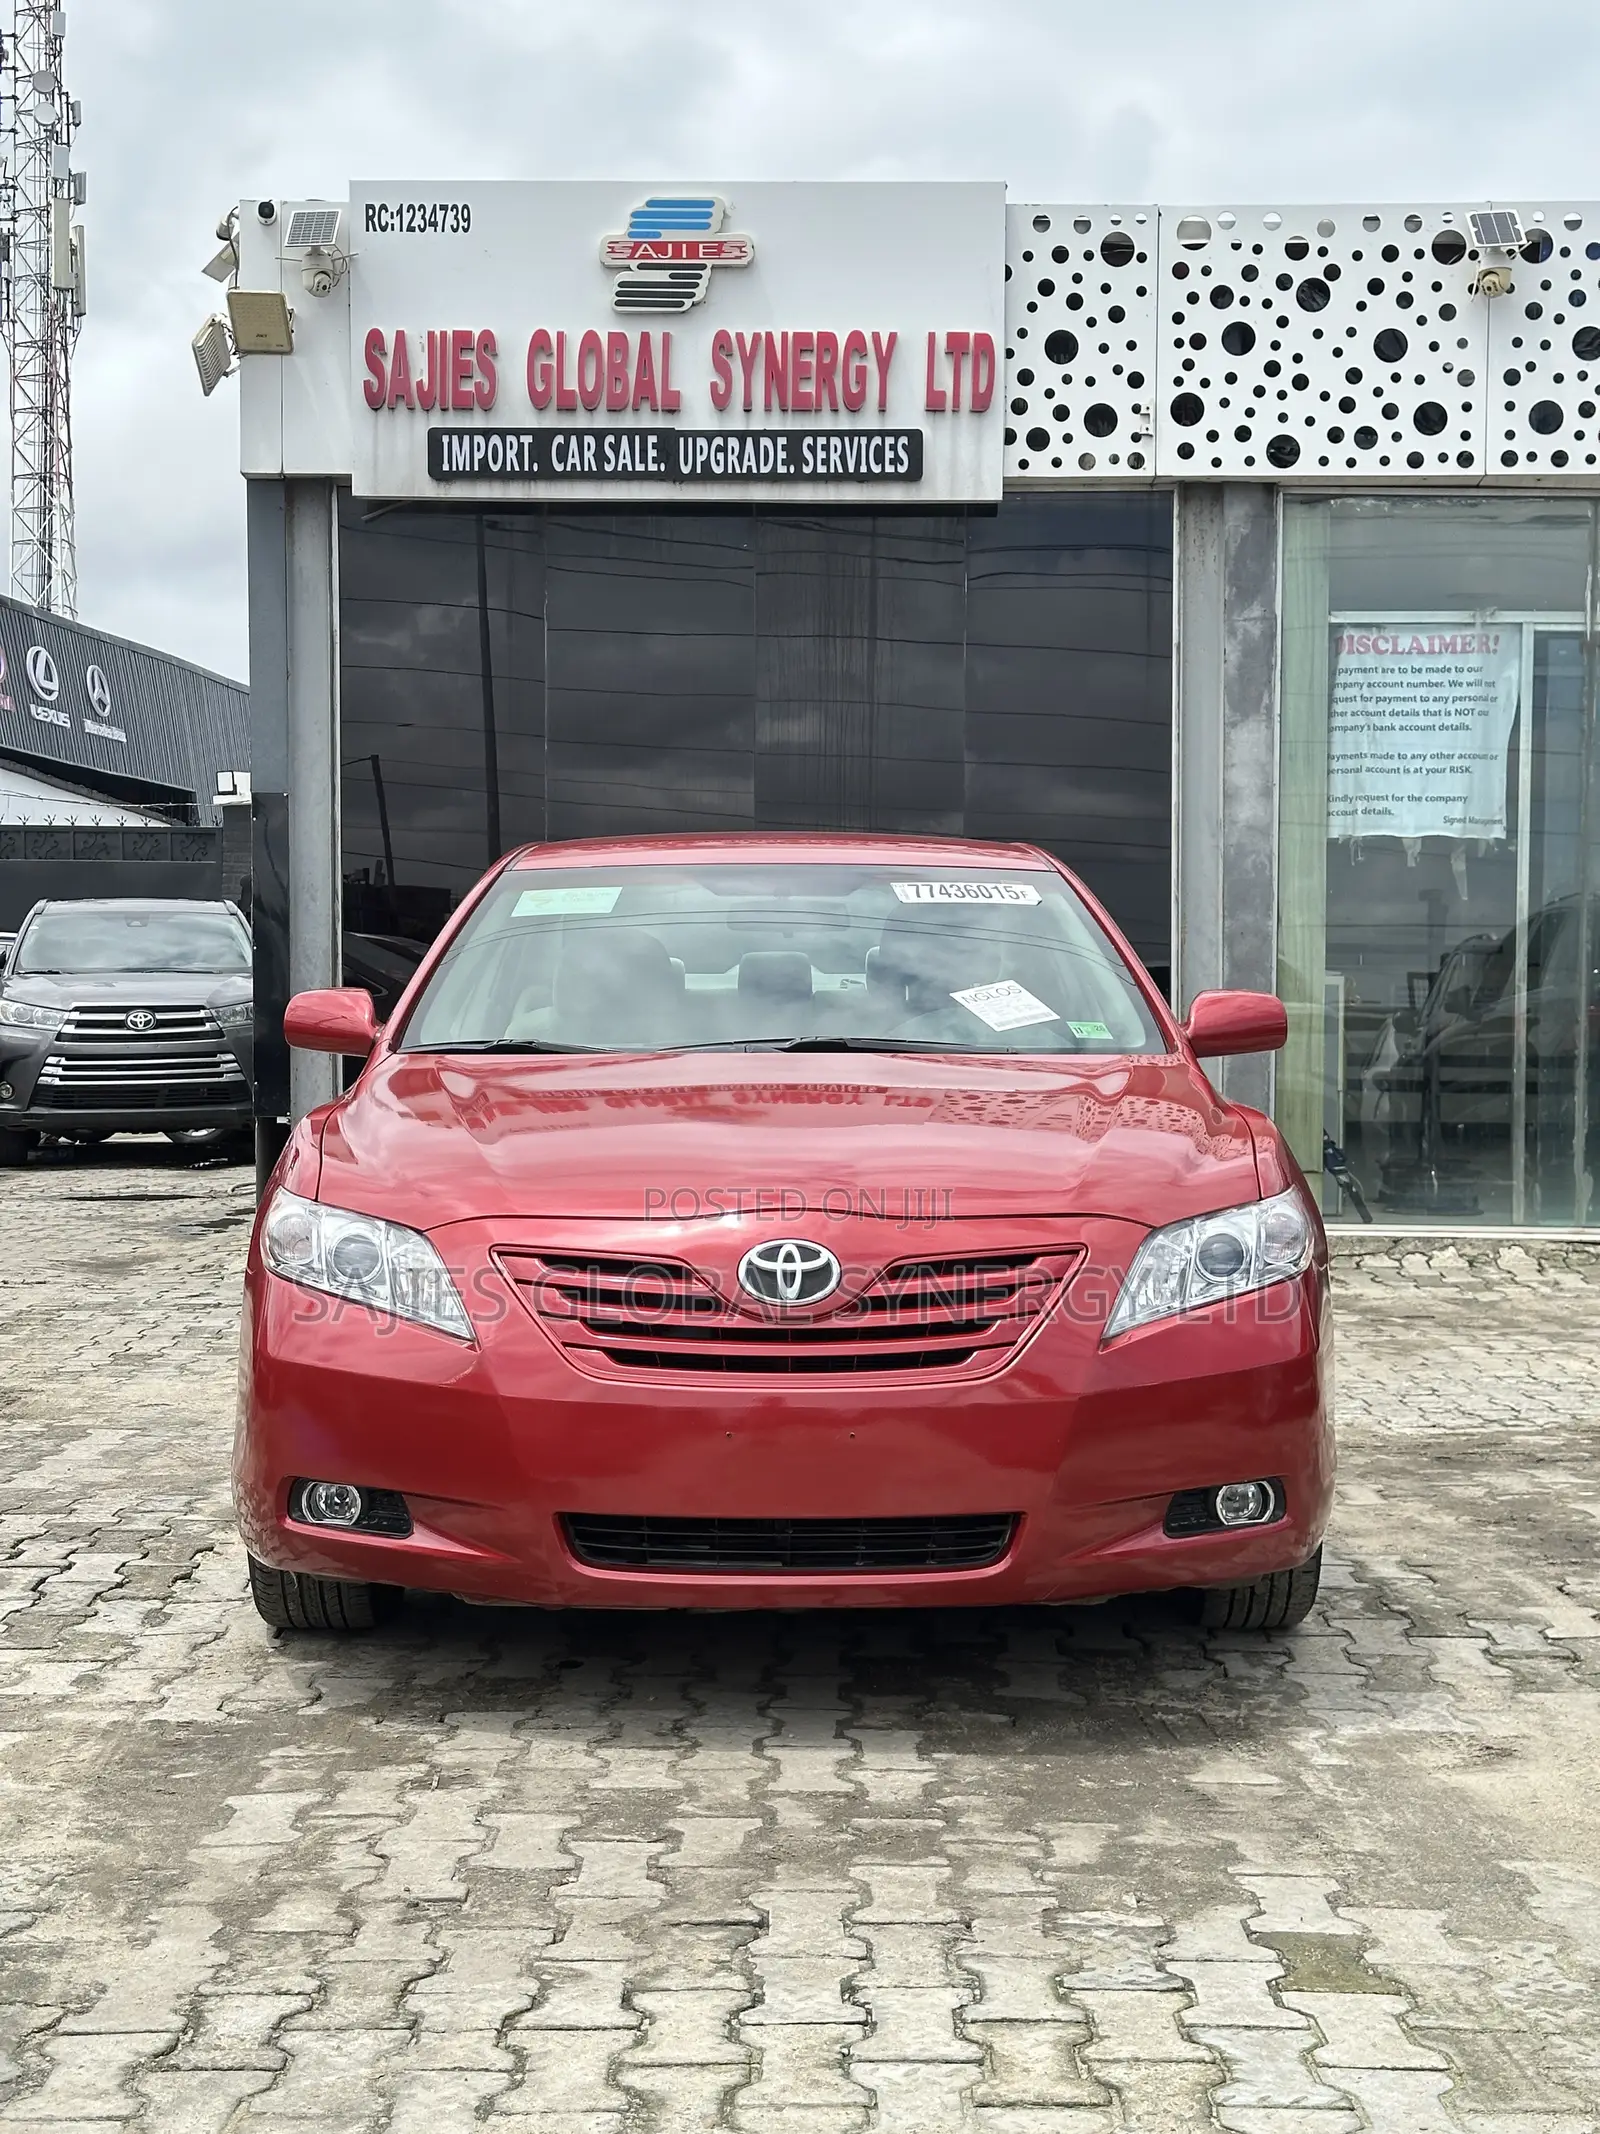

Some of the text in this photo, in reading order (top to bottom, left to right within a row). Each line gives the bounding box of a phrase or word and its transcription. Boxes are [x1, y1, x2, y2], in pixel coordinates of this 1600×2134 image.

[365, 203, 471, 233] RC:1234739
[606, 240, 749, 260] SAJIES
[363, 327, 996, 413] SAJIES GLOBAL SYNERGY LTD
[441, 434, 910, 475] IMPORT. CAR SALE. UPGRADE. SERVICES
[1338, 664, 1484, 676] payment are to be made to our
[1366, 680, 1404, 688] account
[1406, 679, 1446, 688] number.
[1448, 679, 1463, 688] We
[1466, 679, 1483, 688] will
[1360, 694, 1373, 702] for
[1375, 695, 1417, 704] payment
[1432, 695, 1449, 704] any
[29, 703, 71, 729] LEXUS
[1350, 709, 1386, 717] account
[1388, 708, 1420, 717] details
[1422, 708, 1442, 717] that
[1444, 708, 1452, 717] is
[1454, 708, 1475, 717] NOT
[1372, 722, 1396, 732] bank
[1398, 723, 1436, 732] account
[1370, 752, 1395, 760] made
[1397, 752, 1408, 760] to
[1410, 753, 1428, 762] any
[1429, 751, 1455, 760] other
[1365, 766, 1400, 774] account
[1403, 765, 1411, 774] is
[1413, 766, 1423, 774] at
[1425, 766, 1447, 775] your
[1355, 794, 1389, 803] request
[1391, 793, 1405, 802] for
[1407, 793, 1423, 802] the
[1425, 795, 1468, 804] company
[961, 985, 1022, 1004] NGLOS
